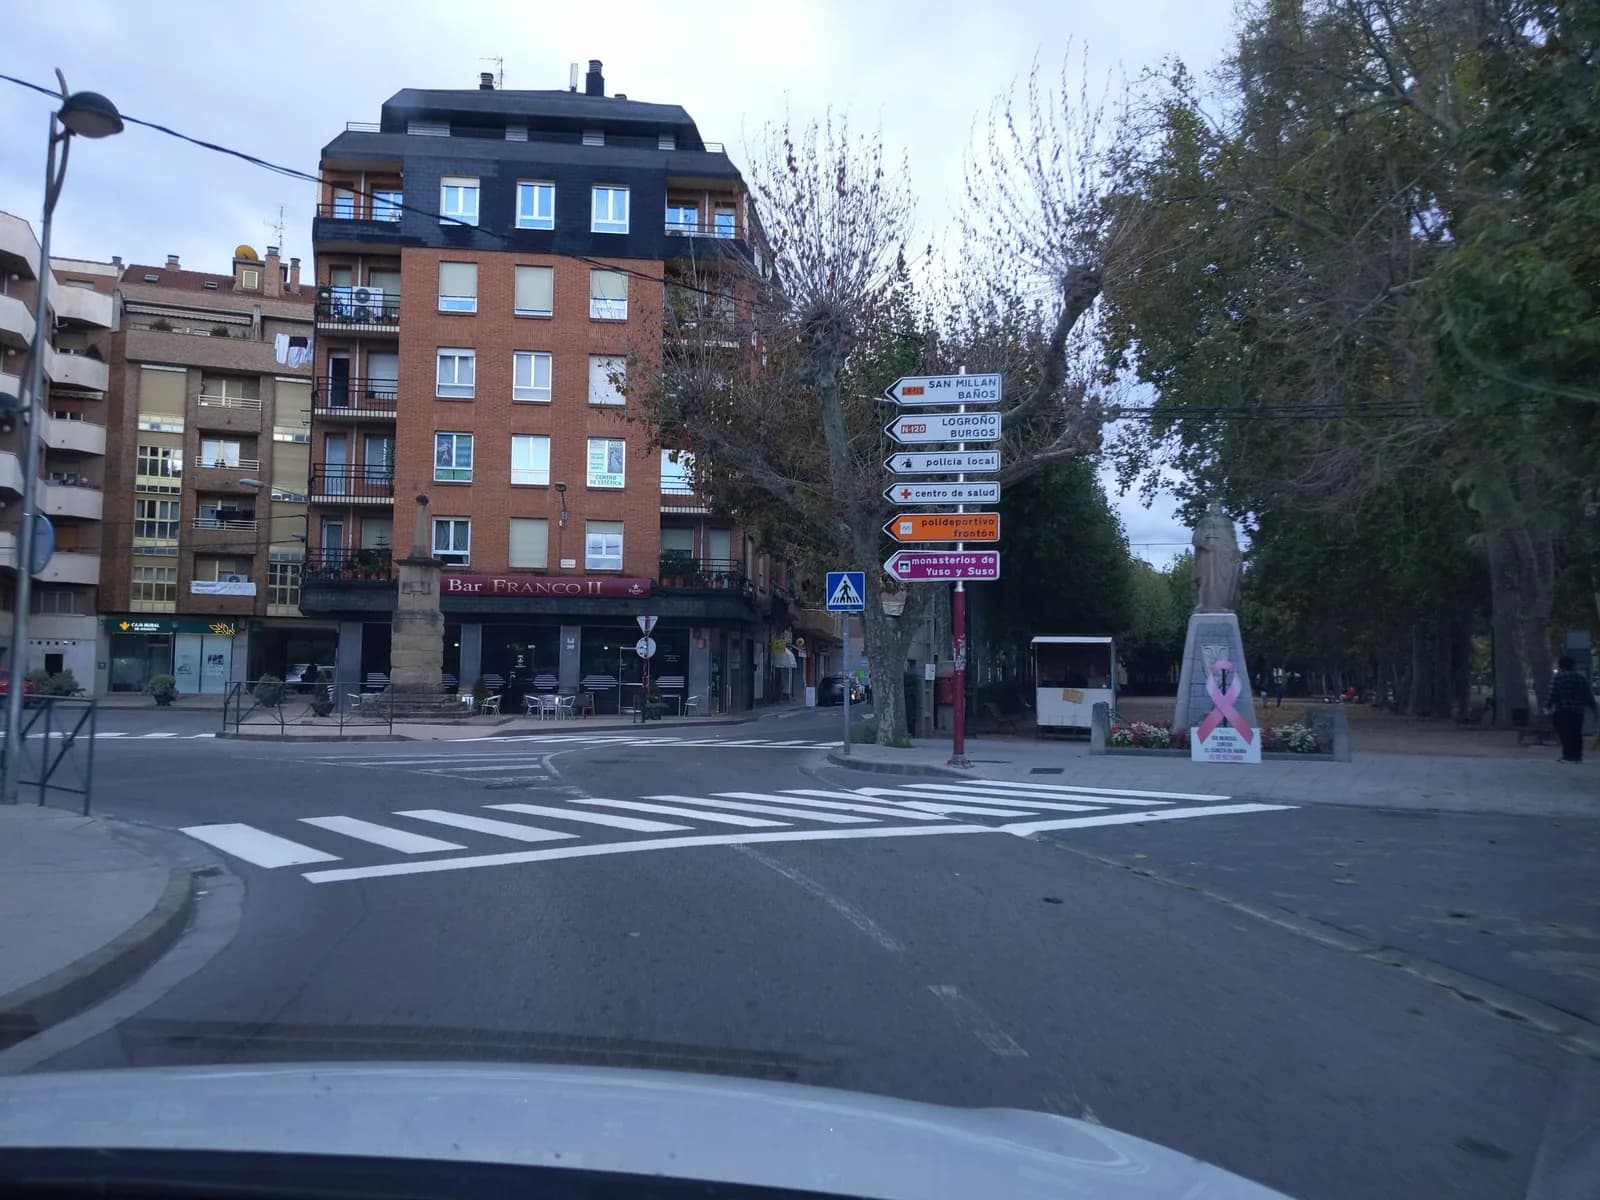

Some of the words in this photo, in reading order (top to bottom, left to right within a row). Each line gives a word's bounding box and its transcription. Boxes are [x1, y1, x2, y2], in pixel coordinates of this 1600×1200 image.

[928, 380, 951, 389] SAN
[958, 388, 996, 400] BAÑOS
[942, 415, 996, 426] LOGROÑO
[901, 425, 926, 433] N-120
[950, 428, 996, 438] BURGOS
[967, 456, 995, 466] local
[915, 489, 948, 497] centro
[951, 488, 963, 497] de
[967, 488, 995, 497] salud
[921, 517, 994, 528] polideportivo
[954, 529, 994, 538] frontón
[911, 556, 977, 565] monasterios
[981, 555, 995, 564] de
[926, 566, 951, 576] Yuso
[956, 568, 963, 577] y
[967, 566, 995, 576] Suso
[448, 578, 482, 592] Bar
[493, 579, 581, 594] FRANCO
[587, 581, 603, 594] II
